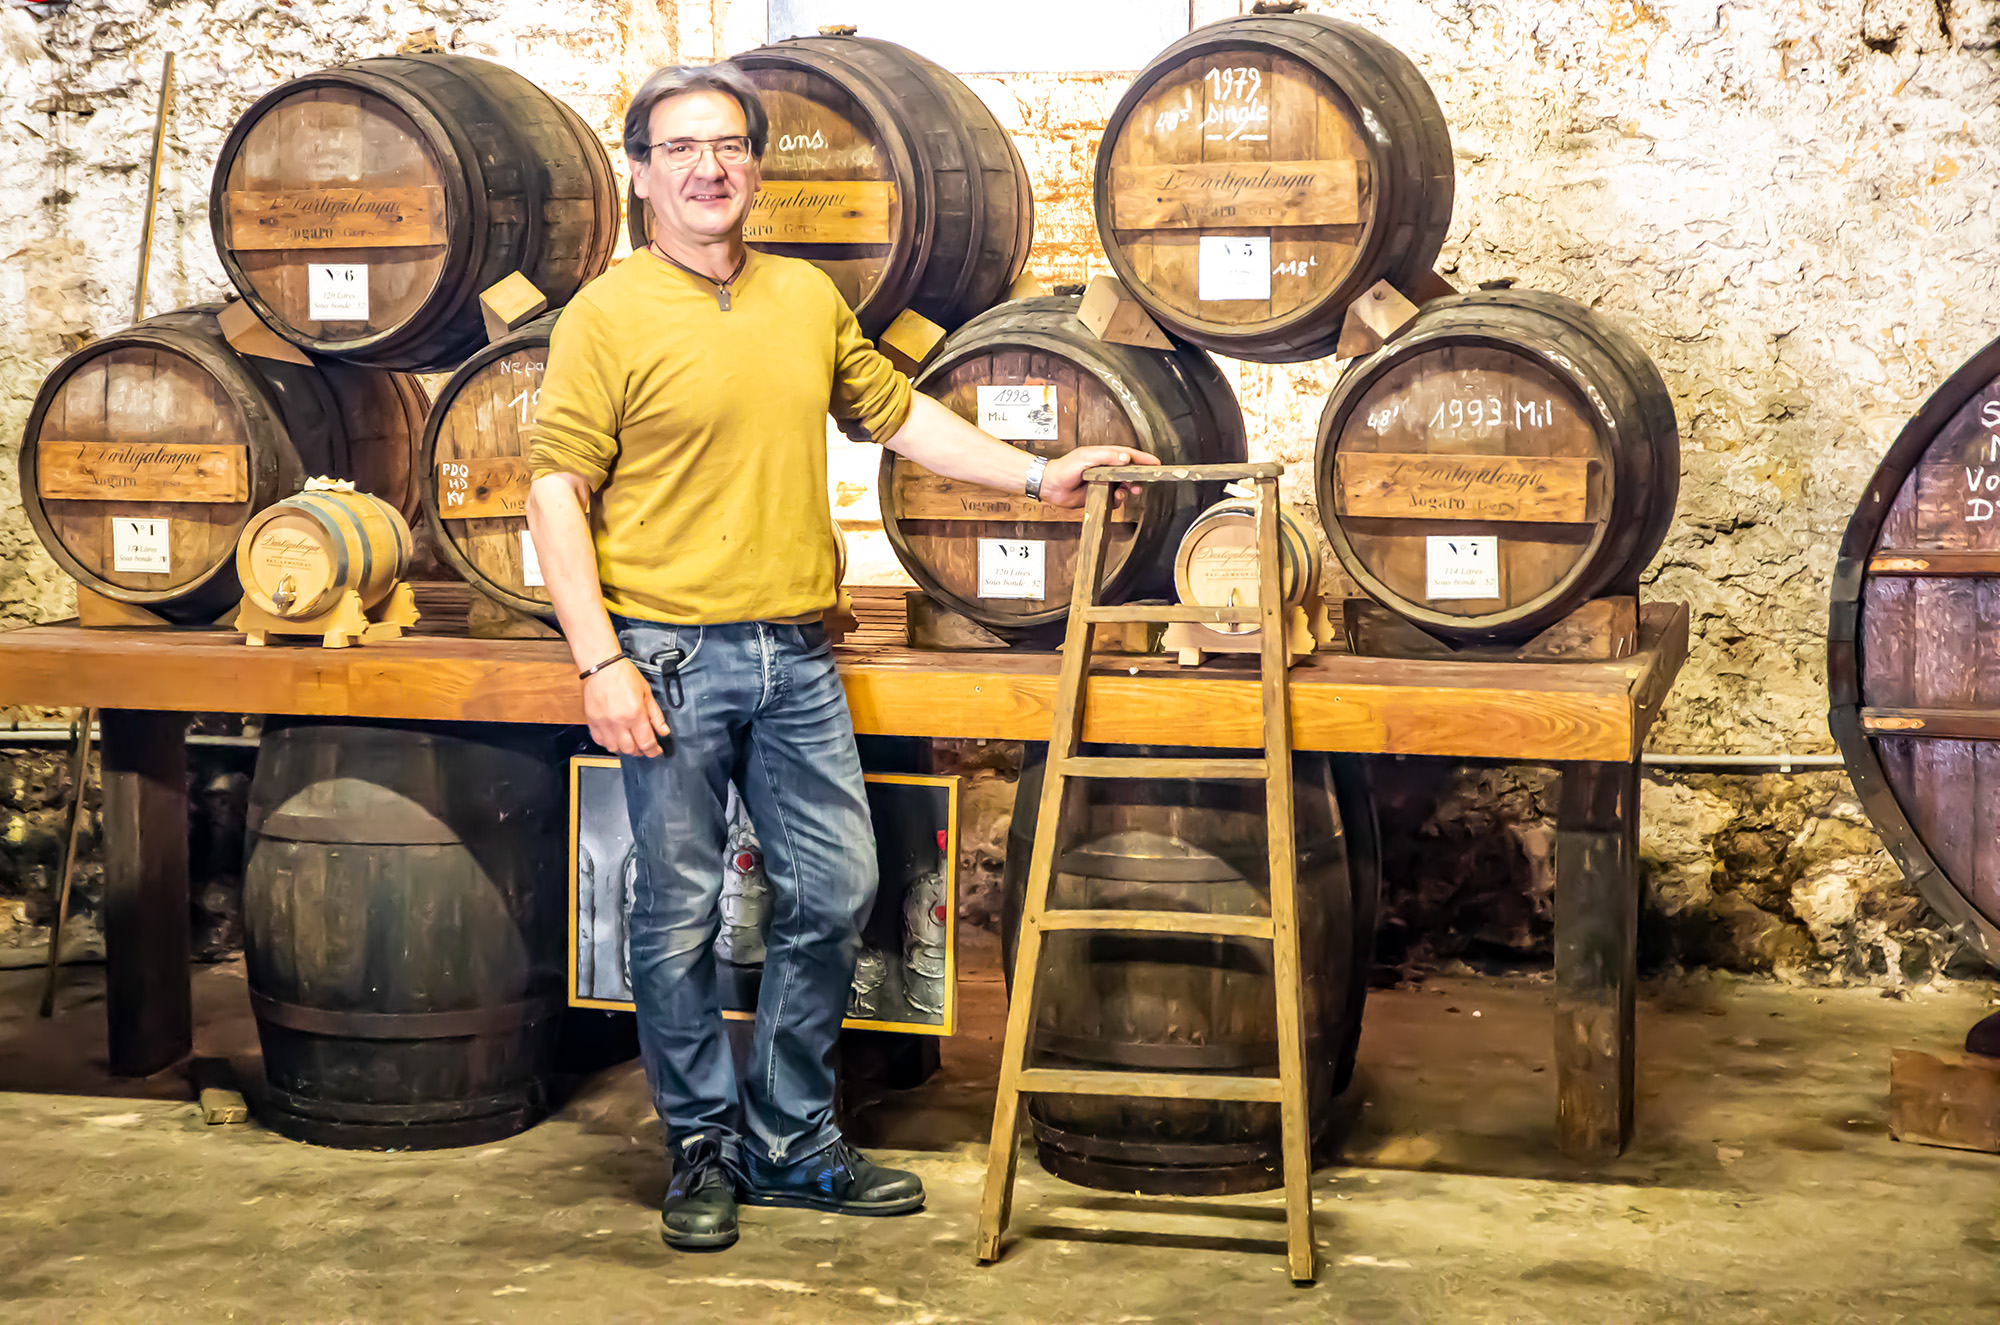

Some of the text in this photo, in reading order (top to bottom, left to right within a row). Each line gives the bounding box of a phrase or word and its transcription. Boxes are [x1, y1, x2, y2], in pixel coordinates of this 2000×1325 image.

[1204, 66, 1262, 103] 1979
[345, 269, 355, 281] 6
[993, 389, 1031, 403] 1998
[1428, 397, 1502, 430] 1993
[442, 463, 469, 478] PDQ
[1019, 545, 1030, 559] 3
[1470, 543, 1480, 556] 7
